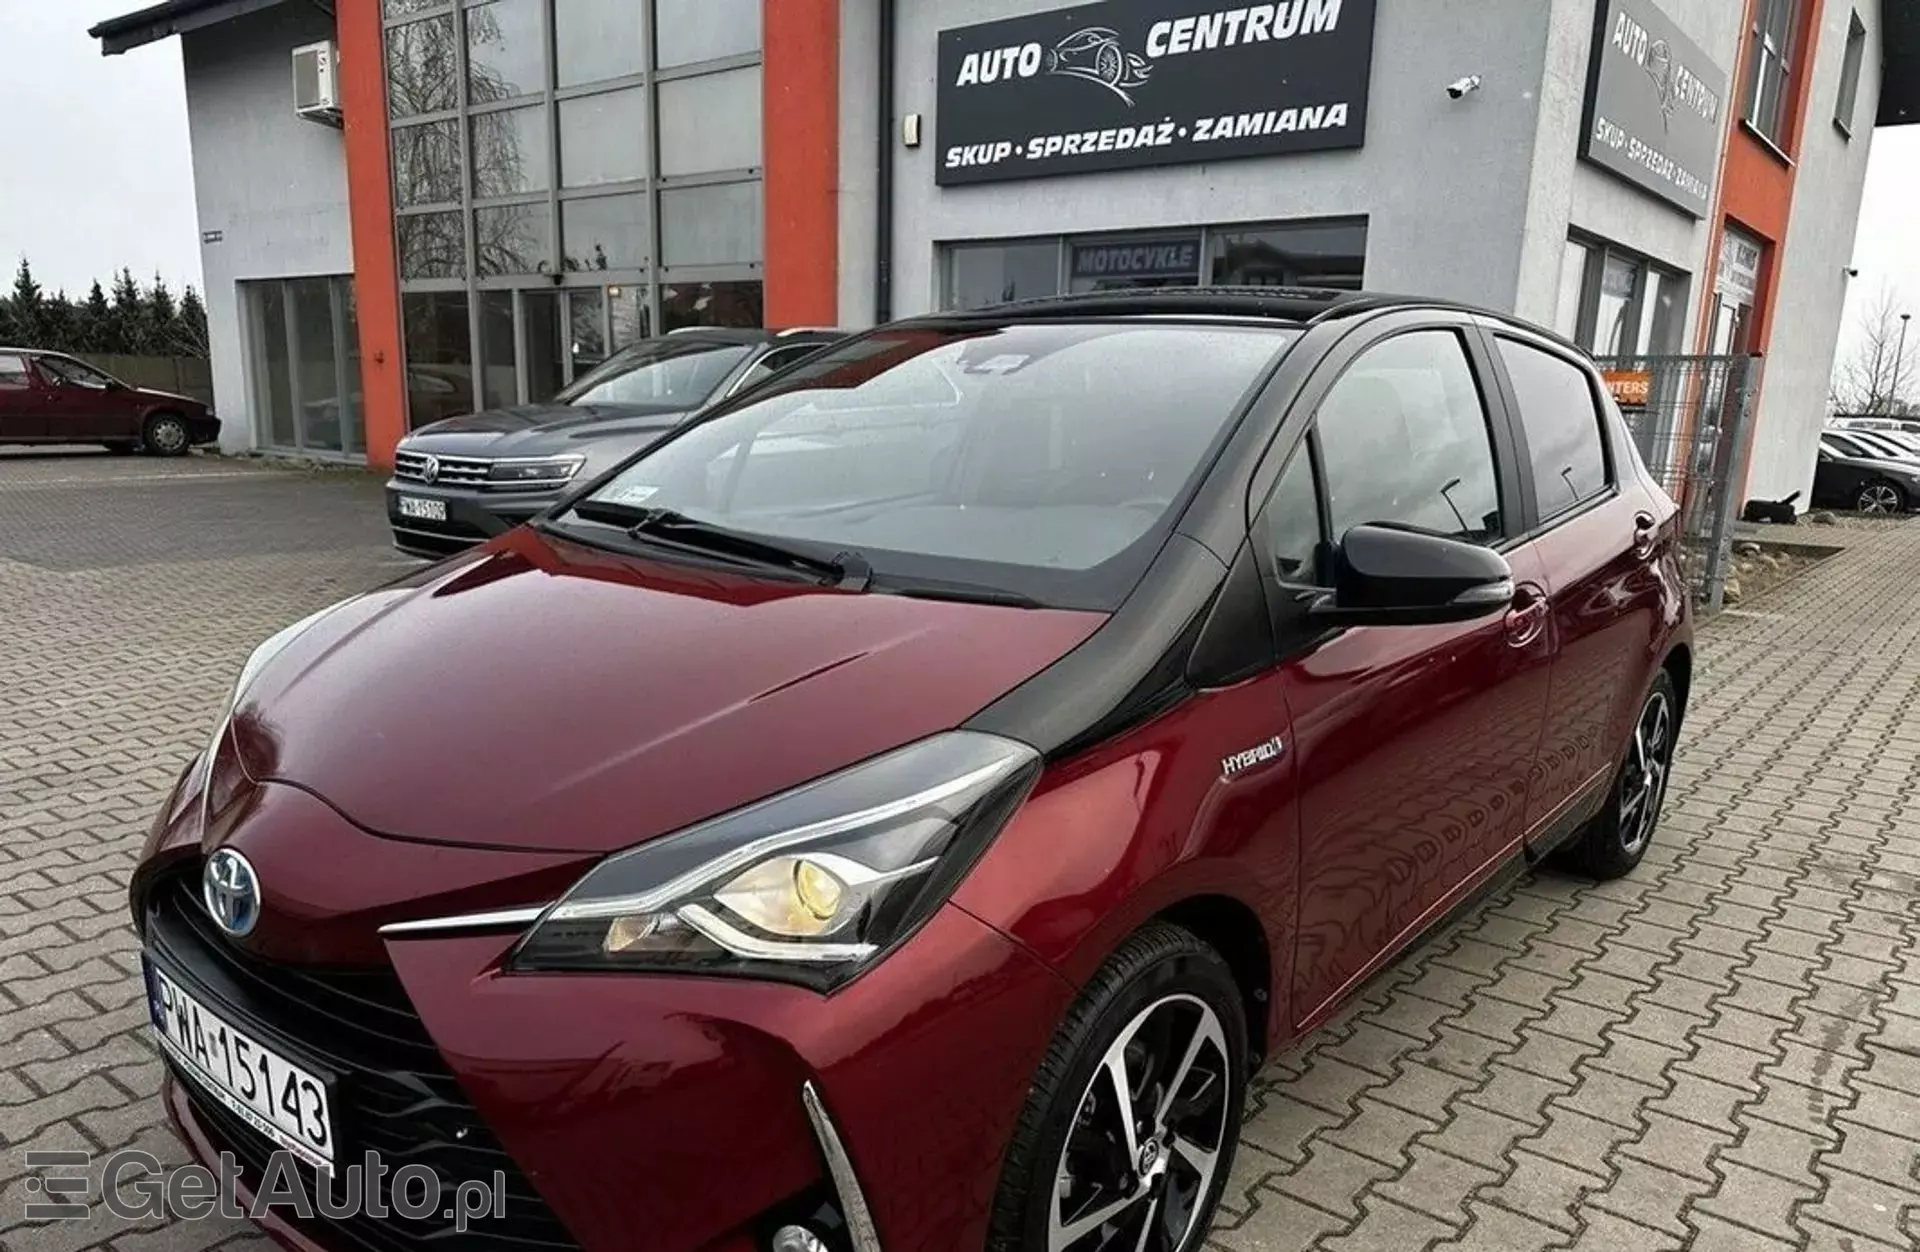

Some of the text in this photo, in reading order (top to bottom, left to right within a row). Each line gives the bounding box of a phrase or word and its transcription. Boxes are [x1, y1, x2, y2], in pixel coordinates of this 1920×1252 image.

[956, 0, 1342, 87] AUTO CENTRUM
[1612, 11, 1647, 66] AUTO
[945, 102, 1349, 168] SKUP SPRZEDAŻ ZAMIANA
[1596, 117, 1625, 150] SKUP
[1077, 244, 1195, 273] MOTOCYKLE
